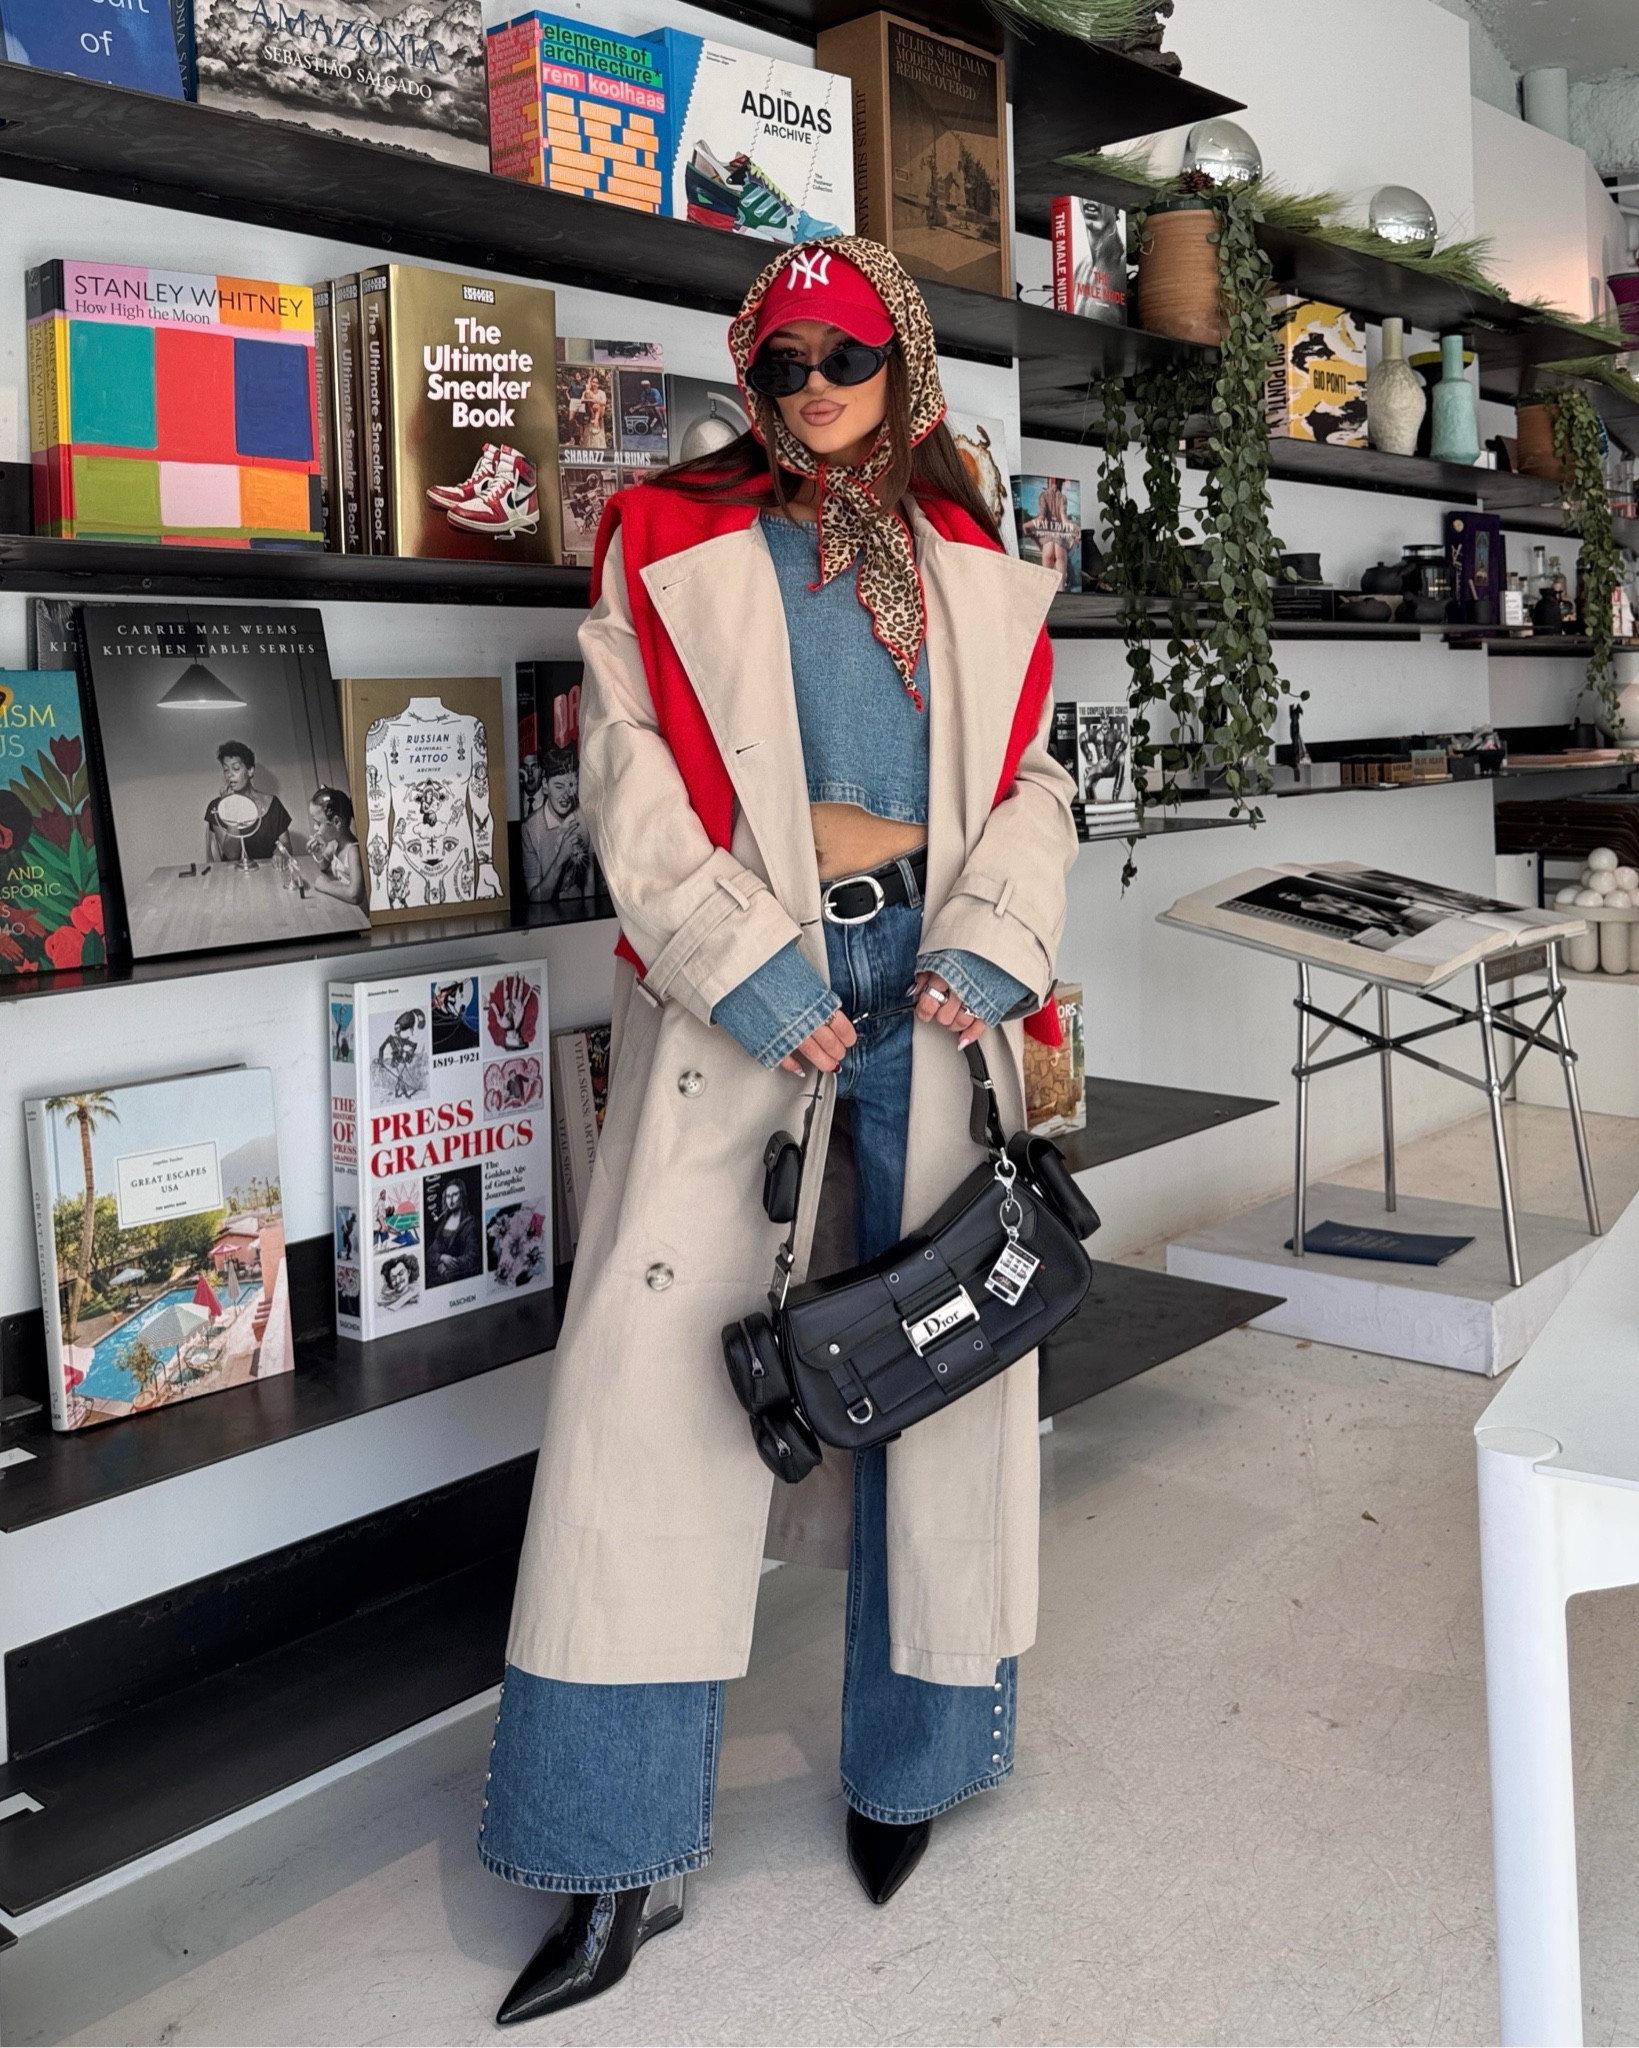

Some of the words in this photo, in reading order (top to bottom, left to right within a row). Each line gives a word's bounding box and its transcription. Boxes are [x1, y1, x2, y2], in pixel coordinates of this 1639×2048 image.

[80, 31, 112, 56] of
[544, 24, 627, 59] elements
[631, 48, 648, 63] of
[895, 31, 934, 56] JULIUS
[937, 44, 989, 77] SHULMAN
[264, 45, 351, 80] SEBASTIÃO
[357, 69, 432, 99] SALGADO
[544, 43, 652, 84] architecture
[895, 46, 961, 81] MODERNISM
[544, 67, 579, 88] rem
[589, 74, 664, 110] koolhaas
[780, 89, 792, 98] THE
[896, 60, 976, 100] REDISCOVERED
[741, 90, 832, 135] ADIDAS
[856, 88, 867, 148] JULIUS
[763, 123, 812, 144] ARCHIVE
[858, 152, 870, 235] SHULMAN
[1055, 212, 1065, 237] THE
[787, 249, 832, 290] NY
[1056, 239, 1066, 275] MALE
[74, 275, 184, 304] STANLEY
[191, 286, 303, 318] WHITNEY
[1057, 277, 1067, 312] NUDE
[1077, 283, 1101, 297] MALE
[1102, 288, 1126, 305] NUDE
[75, 299, 107, 313] How
[111, 303, 143, 319] High
[148, 307, 169, 320] the
[173, 311, 210, 325] Moon
[340, 312, 348, 343] The
[368, 303, 378, 335] The
[455, 317, 502, 344] The
[424, 345, 533, 373] Ultimate
[342, 349, 353, 422] Ultimate
[370, 341, 381, 417] Ultimate
[427, 373, 531, 401] Sneaker
[1268, 369, 1287, 414] PONTI
[1314, 369, 1326, 391] GIO
[1327, 372, 1346, 395] PONTI
[36, 382, 46, 448] WHITNEY
[452, 401, 515, 429] Book
[346, 429, 355, 499] Sneaker
[372, 421, 382, 493] Sneaker
[564, 450, 605, 464] SHABAZZ
[614, 451, 651, 466] ALBUMS
[348, 503, 359, 546] Book
[374, 498, 384, 541] Book
[117, 624, 187, 636] CARRIE
[197, 624, 232, 635] MAE
[240, 624, 298, 636] WEEMS
[103, 643, 187, 656] KITCHEN
[199, 643, 250, 655] TABLE
[259, 643, 316, 655] SERIES
[407, 733, 450, 744] RUSSIAN
[409, 754, 448, 764] TATTOO
[7, 865, 45, 881] AND
[574, 1041, 586, 1082] VITAL
[332, 1096, 356, 1113] THE
[578, 1083, 590, 1118] SIGNS:
[333, 1121, 356, 1143] OF
[370, 1099, 474, 1146] PRESS
[334, 1143, 357, 1154] PRESS
[370, 1118, 534, 1179] GRAPHICS
[558, 1118, 568, 1155] VITAL
[563, 1155, 573, 1194] SIGNS
[131, 1175, 163, 1188] GREAT
[166, 1166, 207, 1181] ESCAPES
[485, 1161, 499, 1170] The
[485, 1168, 511, 1180] Golden
[513, 1165, 526, 1174] Age
[161, 1184, 179, 1193] USA
[485, 1181, 492, 1190] of
[494, 1175, 523, 1188] Graphic
[485, 1186, 525, 1201] Journalism
[34, 1192, 43, 1237] GREAT
[39, 1244, 49, 1303] ESCAPES
[448, 1294, 477, 1307] TASCHEN
[922, 1310, 959, 1337] Dior
